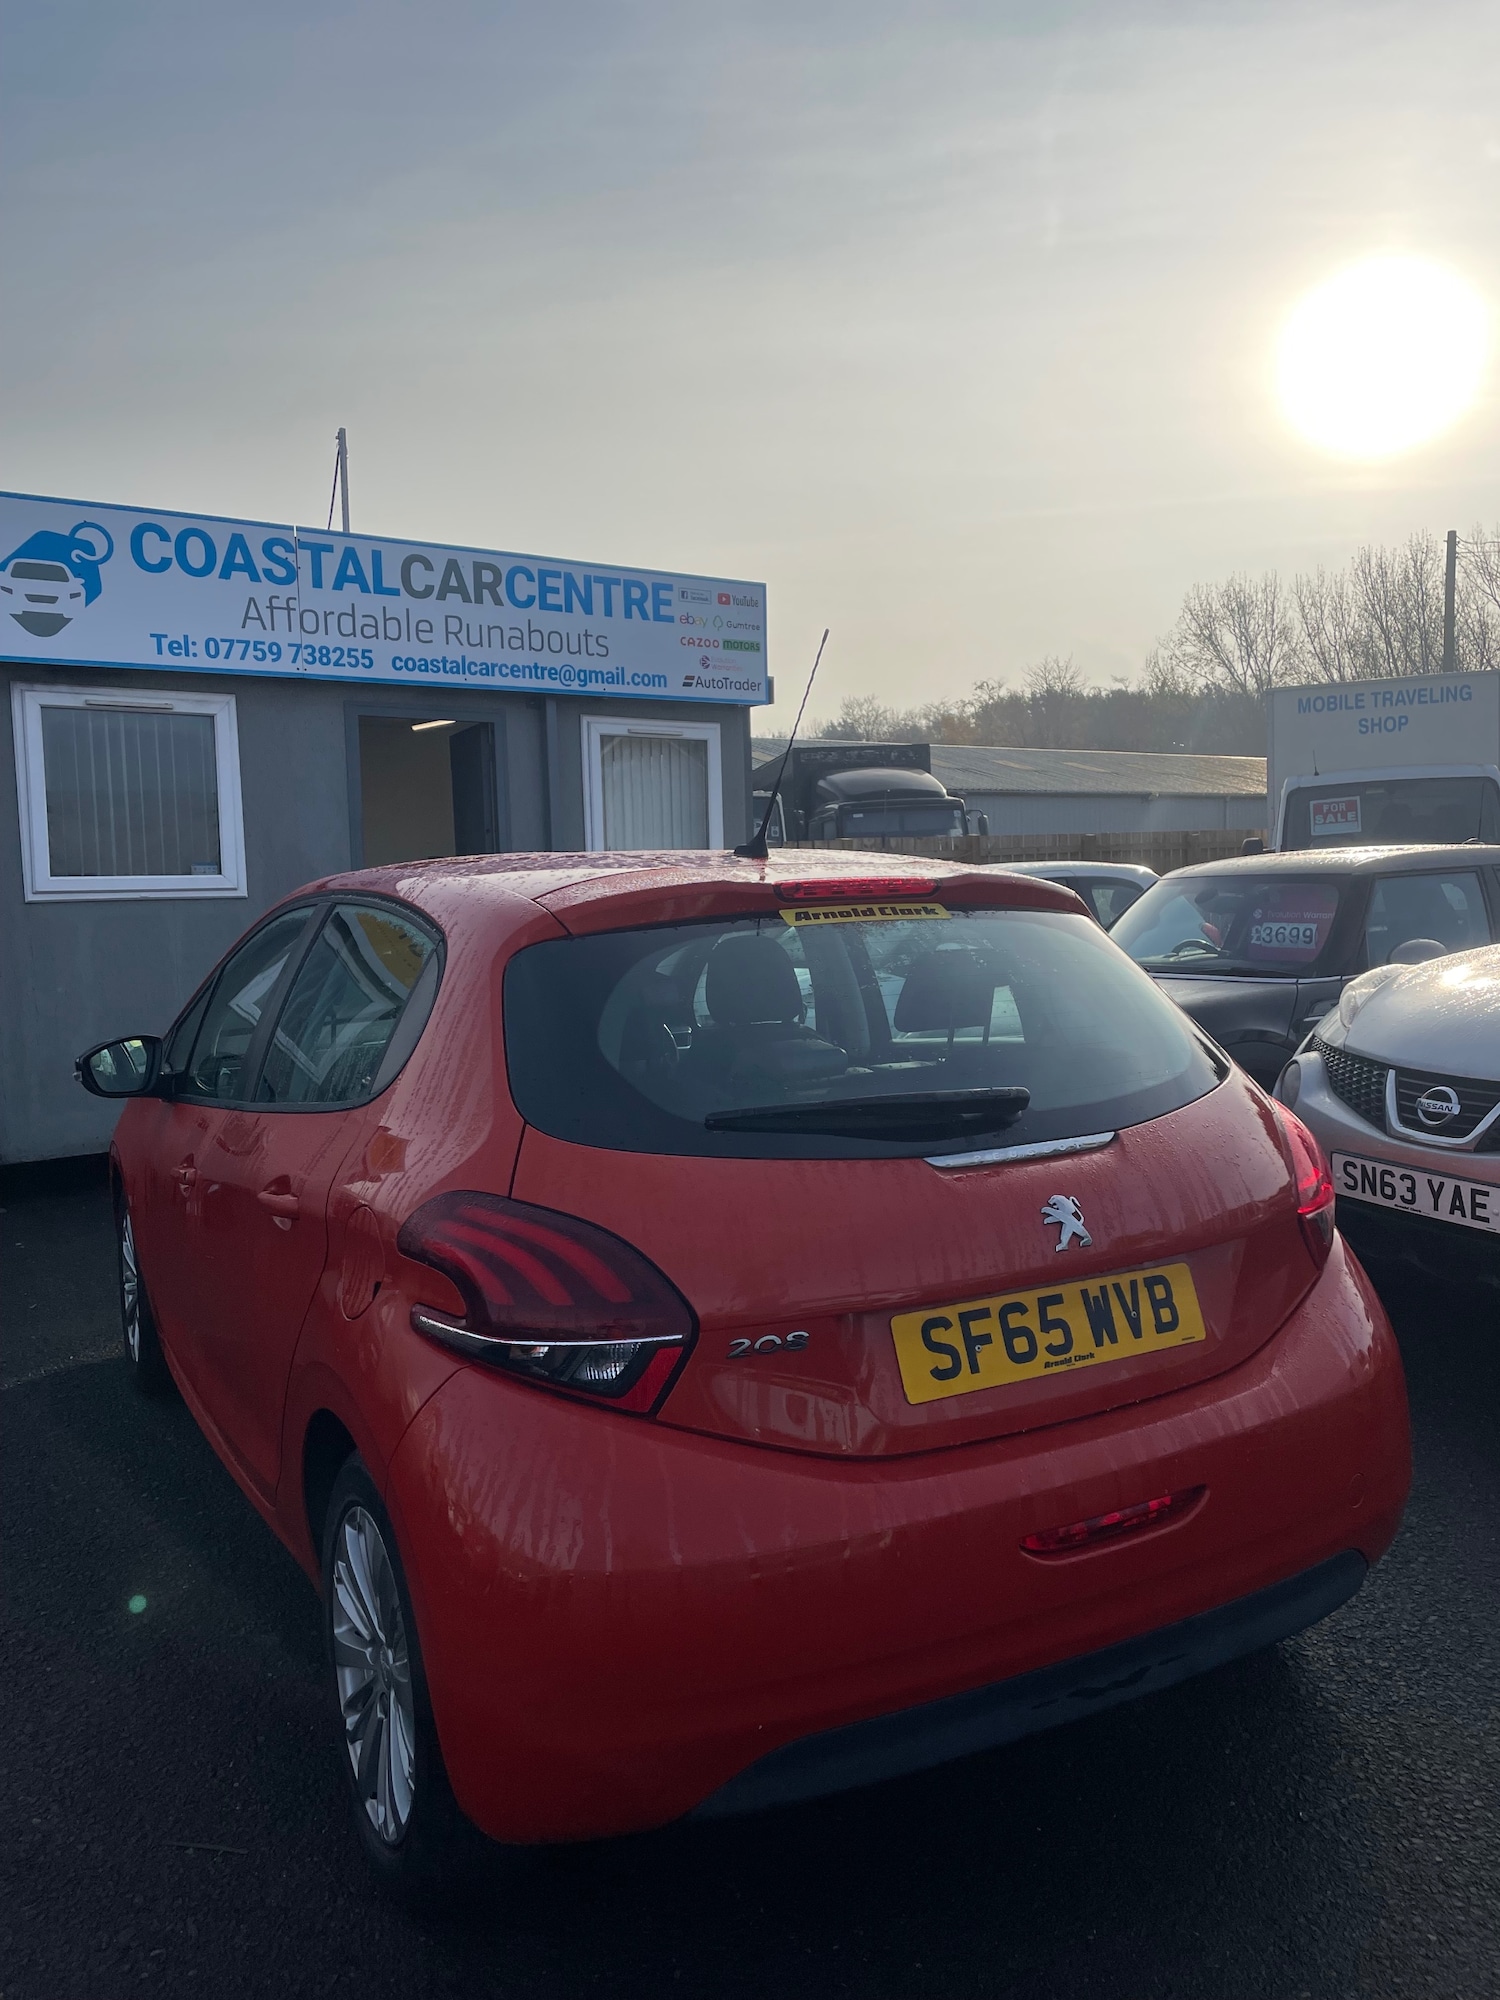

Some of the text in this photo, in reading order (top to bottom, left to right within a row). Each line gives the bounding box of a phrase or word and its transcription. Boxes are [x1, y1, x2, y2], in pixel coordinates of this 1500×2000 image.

[732, 595, 758, 607] YouTube
[241, 595, 610, 658] Affordable Runabouts
[680, 612, 707, 628] ebay
[726, 620, 760, 630] Gumtree
[150, 633, 374, 669] Tel: 07759 738255
[680, 636, 719, 648] CAZOO
[391, 654, 668, 688] coastalcarcentre@gmail.com
[695, 675, 762, 691] AutoTrader
[1297, 684, 1473, 715] MOBILE TRAVELING
[1358, 715, 1409, 735] SHOP
[1322, 802, 1346, 813] FOR
[1314, 811, 1357, 824] SALE
[794, 905, 939, 922] Arnold Clark
[1250, 924, 1315, 945] £3699
[1418, 1101, 1454, 1112] NISSAN
[1342, 1160, 1491, 1224] SN63 YAE
[921, 1274, 1180, 1382] SF65 WVB
[726, 1329, 810, 1359] 208
